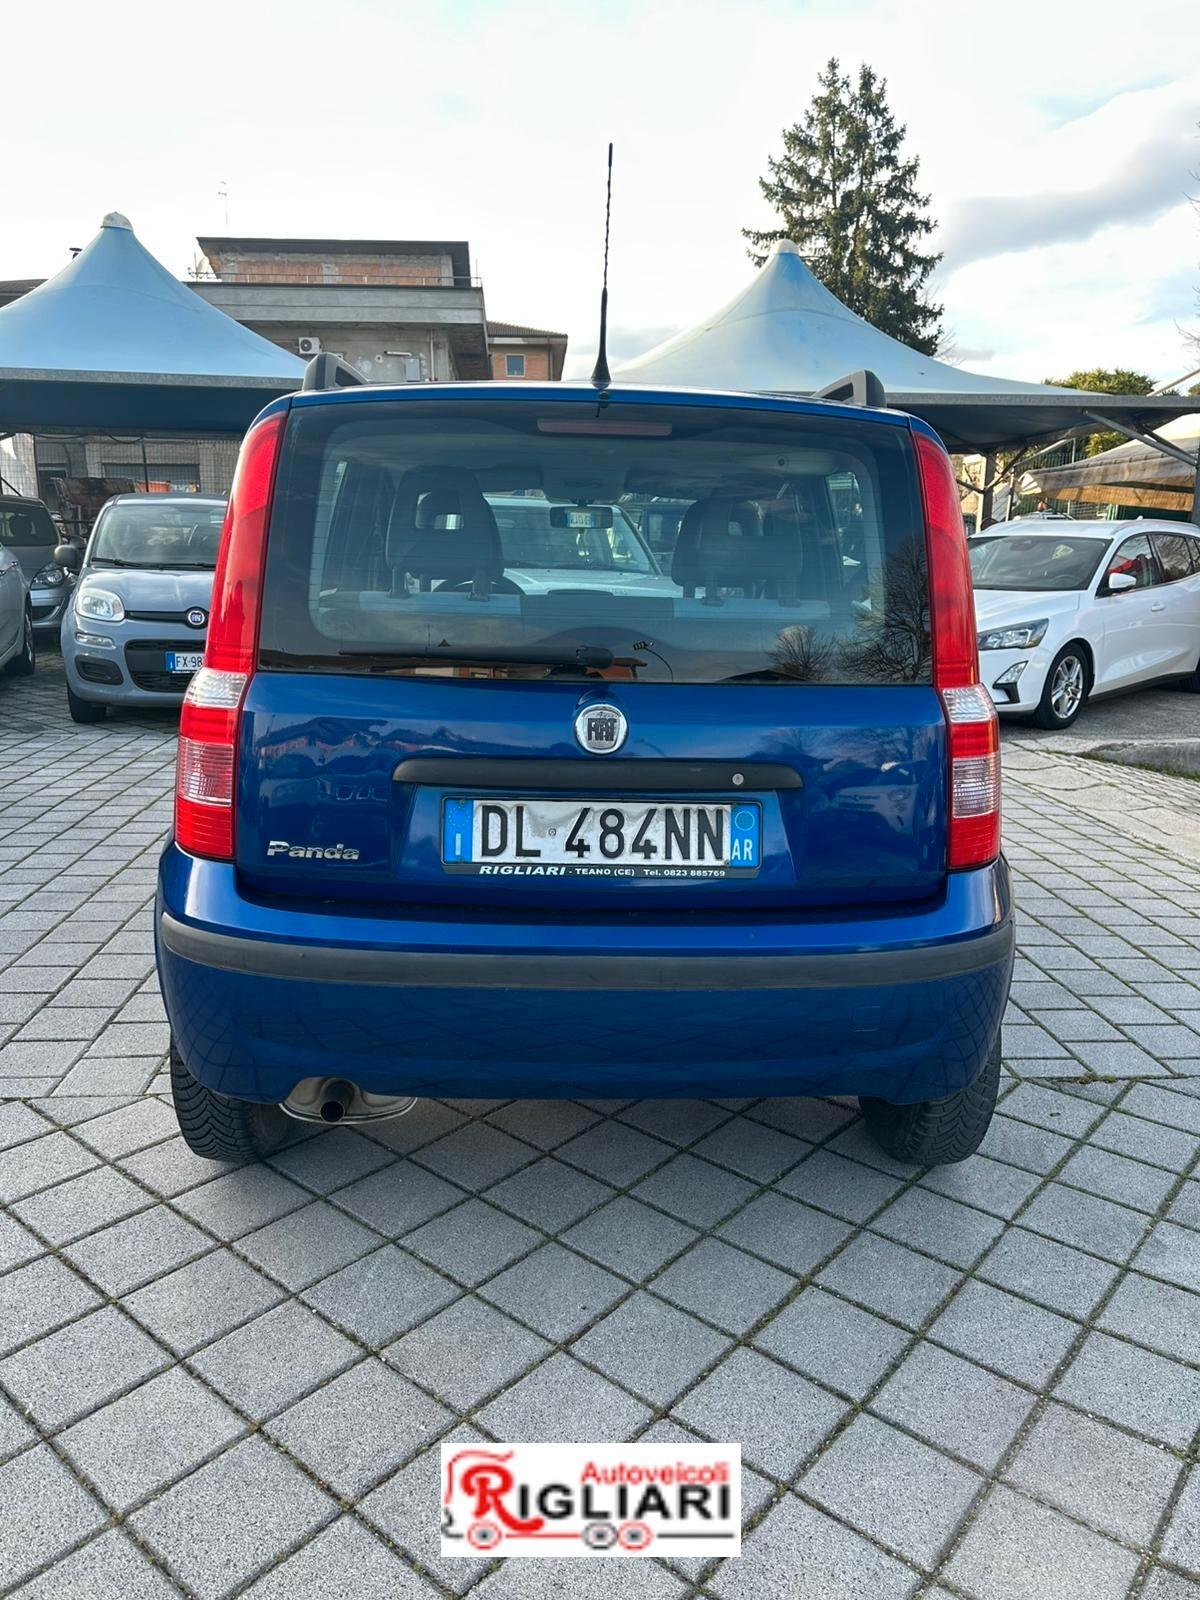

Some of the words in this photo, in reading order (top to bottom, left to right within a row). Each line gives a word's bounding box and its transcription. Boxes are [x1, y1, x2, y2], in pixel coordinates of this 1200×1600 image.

[176, 656, 188, 667] FX
[191, 656, 205, 667] 98
[587, 718, 617, 741] FIAT
[481, 804, 541, 858] DL
[565, 807, 724, 861] 484NN
[731, 838, 753, 861] AR
[267, 840, 360, 860] Panda
[479, 865, 566, 876] RIGLIARI
[575, 868, 611, 876] TEANO
[614, 868, 635, 877] (CE)
[643, 869, 662, 877] Tel.
[664, 869, 688, 877] 0823
